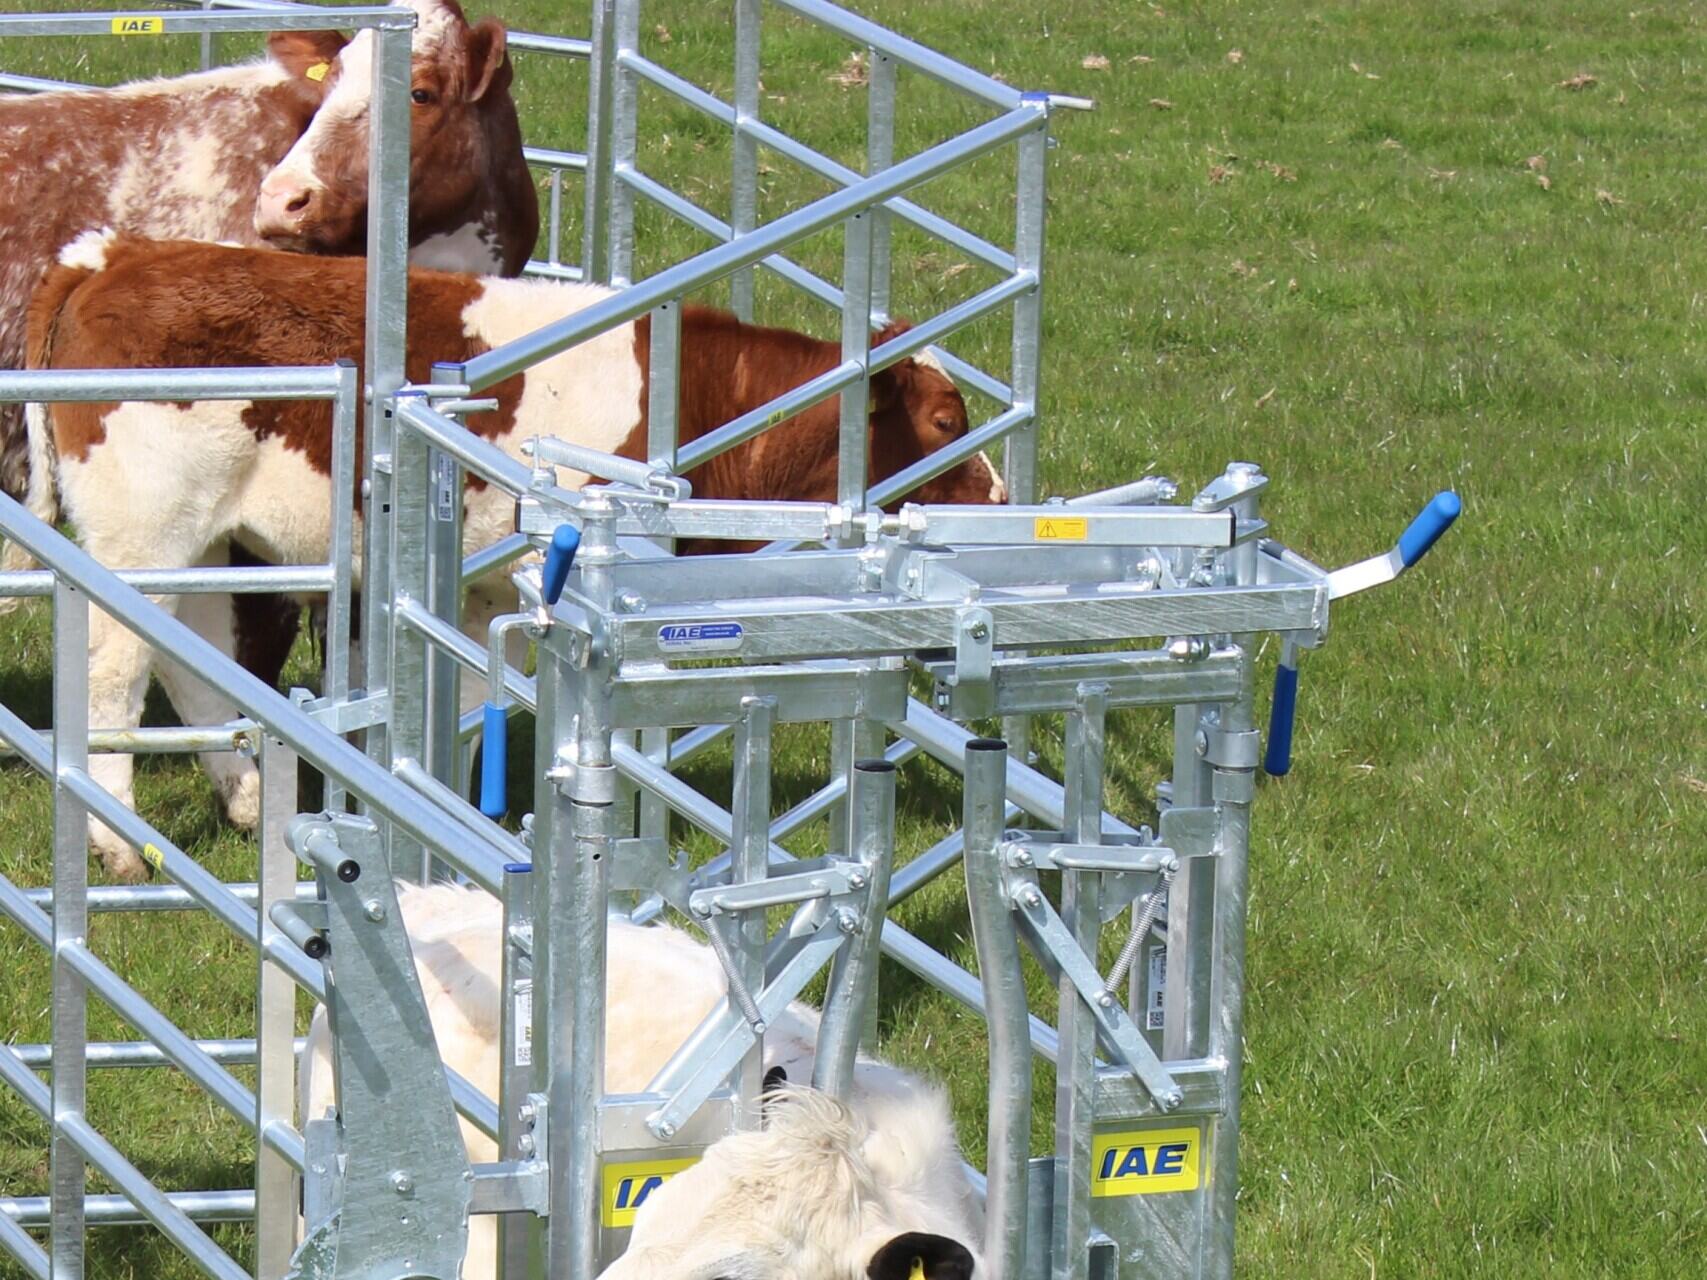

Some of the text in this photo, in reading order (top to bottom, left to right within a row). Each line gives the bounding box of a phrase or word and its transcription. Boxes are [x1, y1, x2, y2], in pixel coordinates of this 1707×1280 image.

[121, 20, 152, 31] IAE
[669, 627, 700, 639] IAE
[1099, 1143, 1188, 1179] IAE
